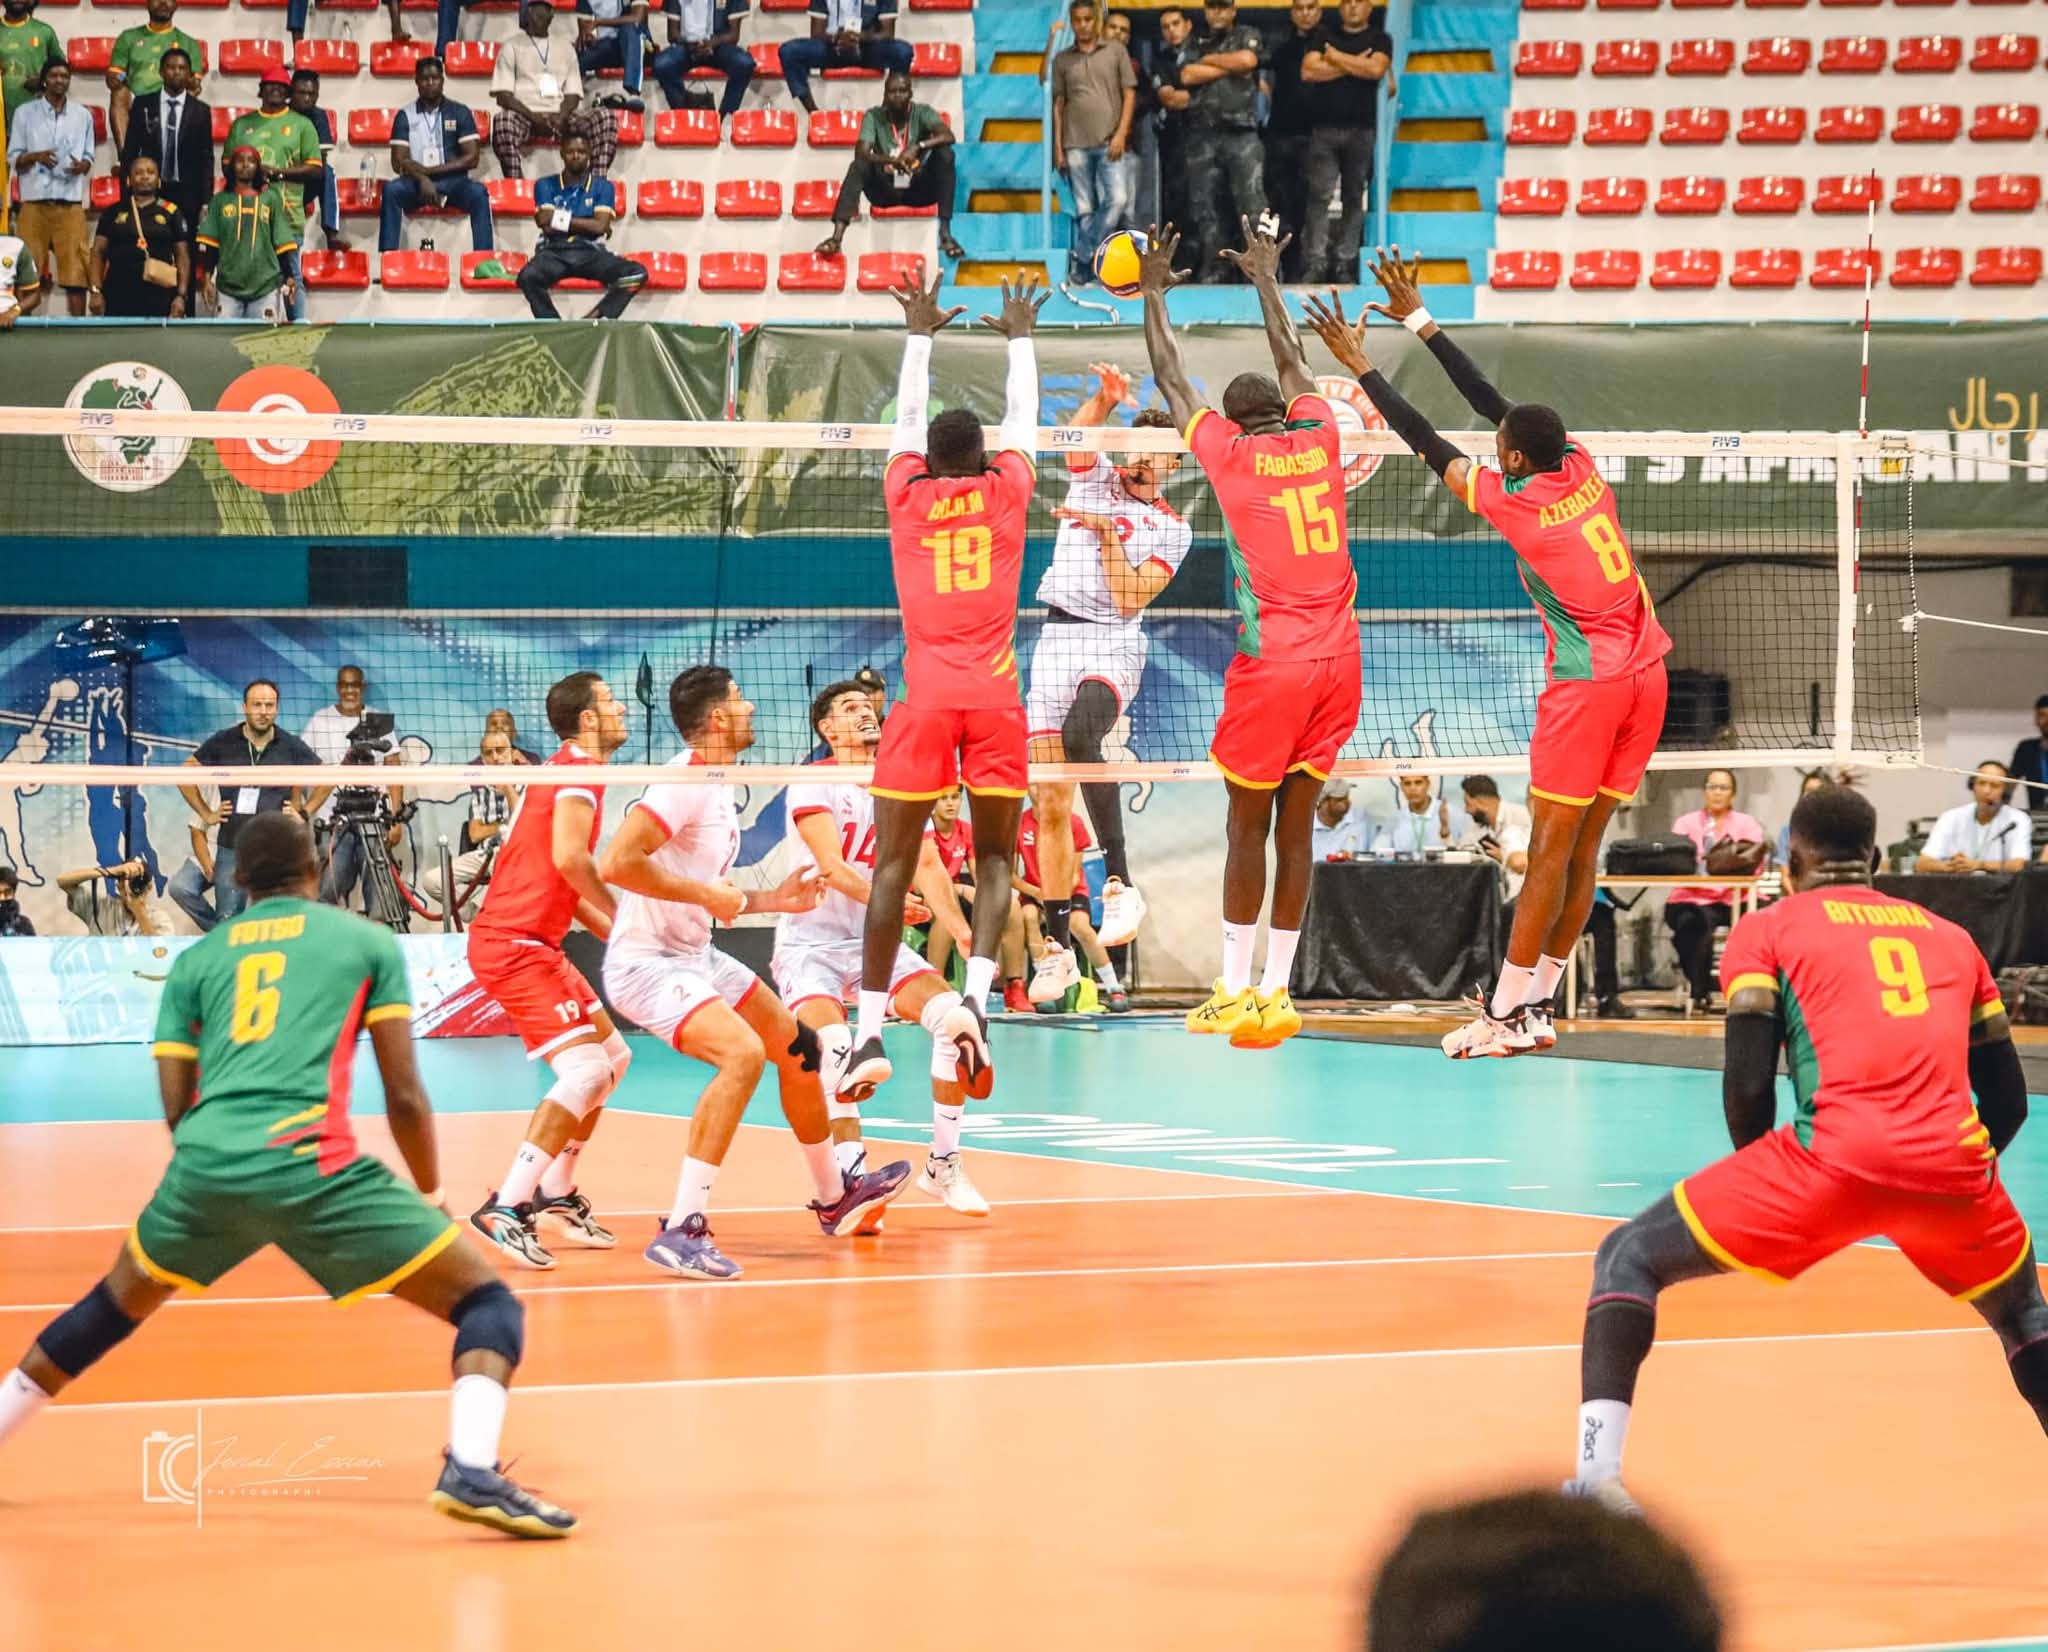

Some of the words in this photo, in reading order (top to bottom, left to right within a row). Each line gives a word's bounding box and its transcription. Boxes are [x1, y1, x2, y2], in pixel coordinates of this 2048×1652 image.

[1053, 430, 1083, 442] FIVB
[1712, 436, 1740, 447] FIVB
[1948, 377, 2039, 443] رجال
[1269, 480, 1339, 556] 15
[1581, 513, 1630, 584] 8
[921, 525, 991, 594] 19
[230, 951, 287, 1044] 6
[1869, 936, 1930, 1017] 9
[554, 1000, 581, 1024] 19
